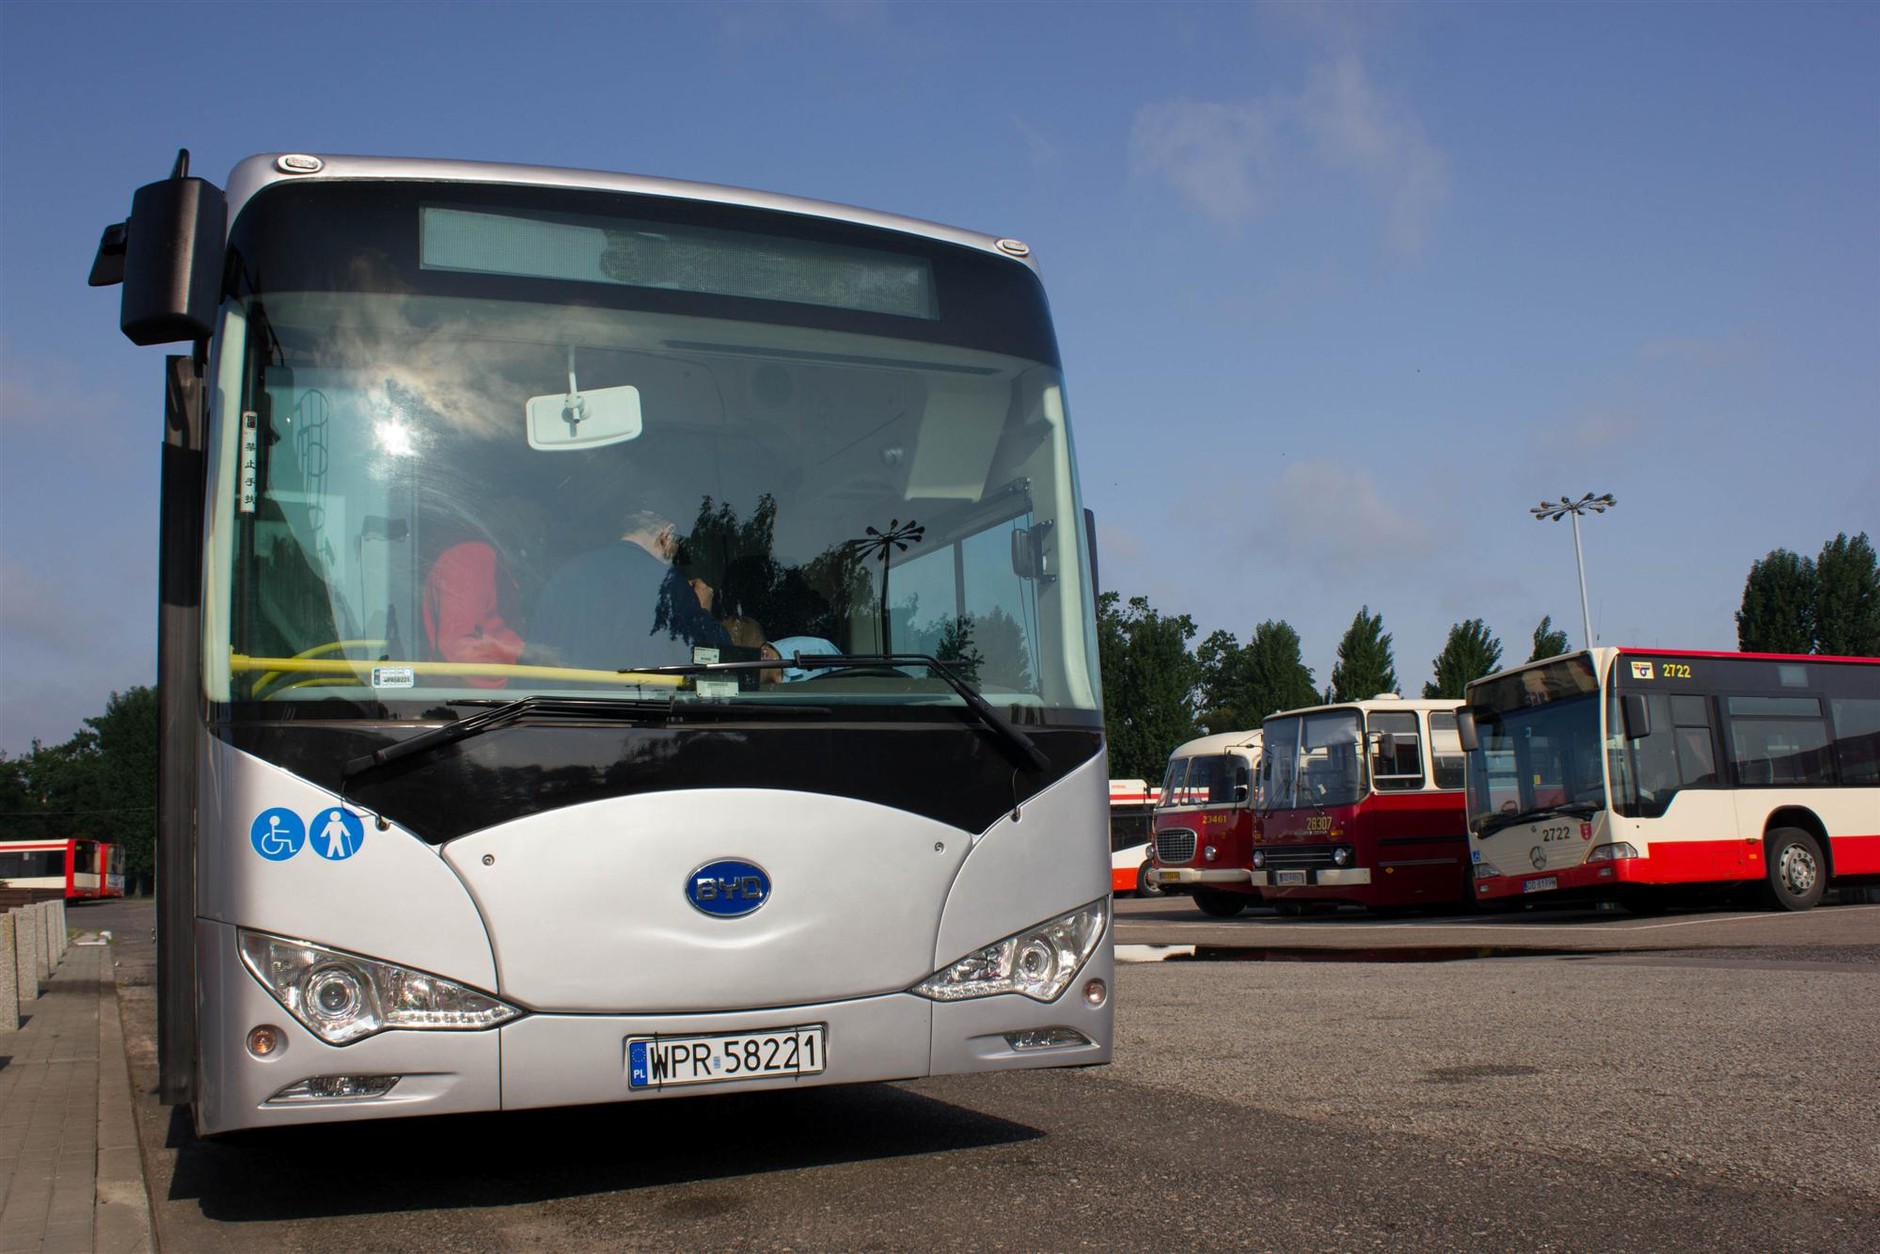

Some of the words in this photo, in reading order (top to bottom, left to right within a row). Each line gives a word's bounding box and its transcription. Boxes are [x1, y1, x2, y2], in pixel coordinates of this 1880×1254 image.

[1662, 663, 1691, 678] 2722
[1202, 815, 1227, 824] 23461
[1542, 826, 1571, 842] 2722
[696, 875, 762, 901] BYD
[650, 1043, 712, 1081] WPR
[724, 1034, 815, 1074] 58221
[633, 1069, 646, 1080] PL
